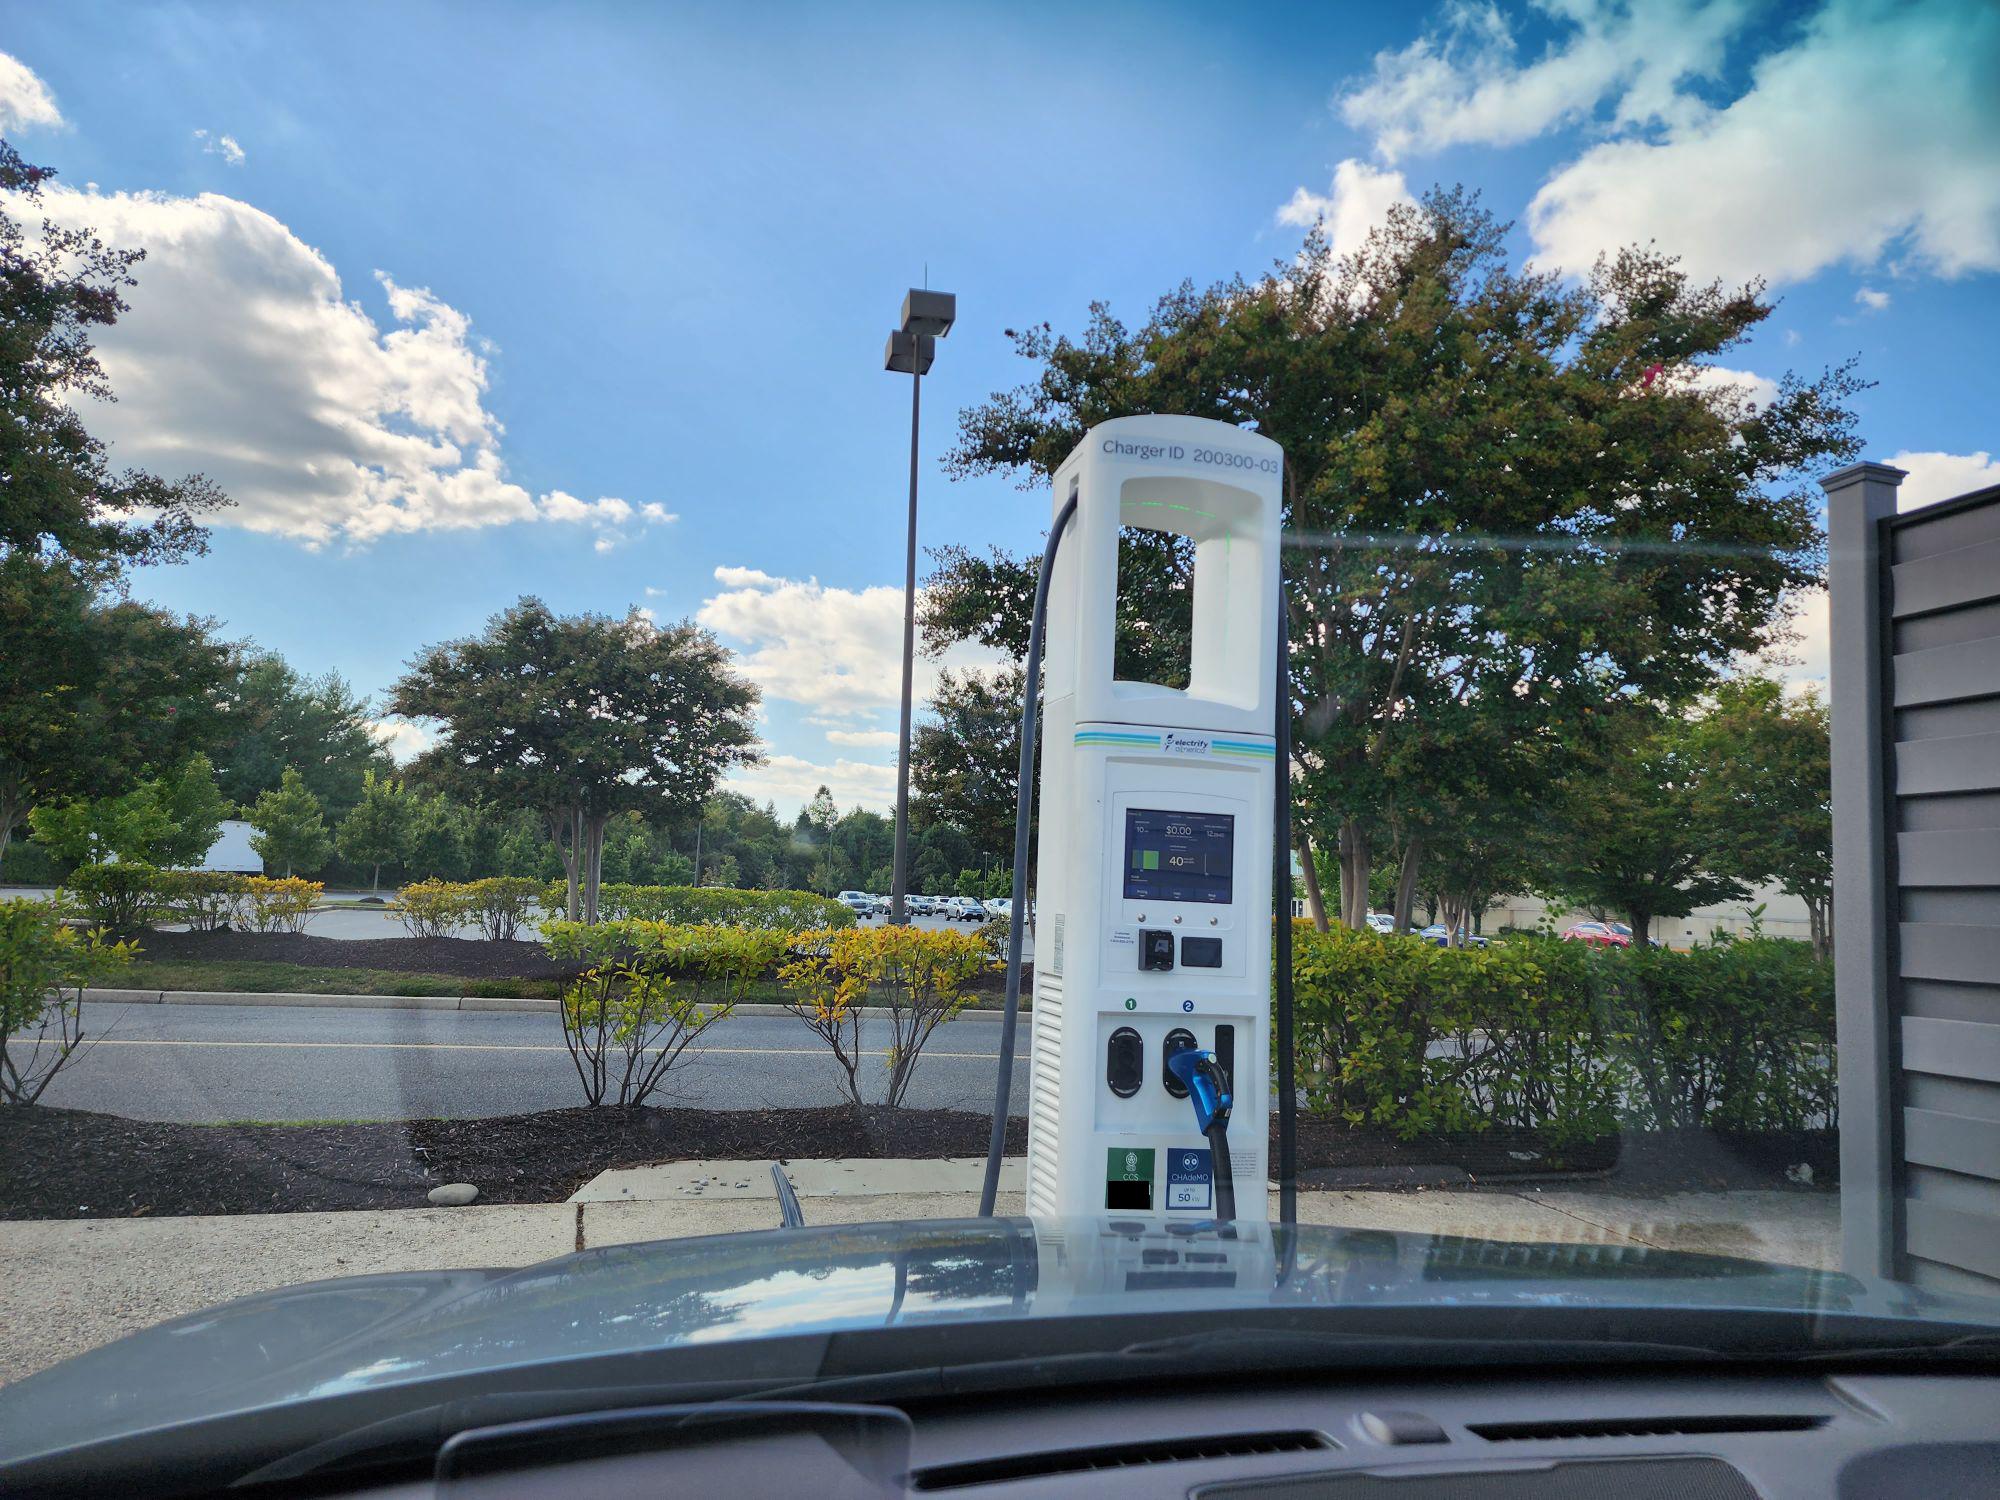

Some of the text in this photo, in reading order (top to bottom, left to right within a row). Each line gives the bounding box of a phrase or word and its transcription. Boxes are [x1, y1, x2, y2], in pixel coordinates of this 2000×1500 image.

[1102, 439, 1279, 474] Charger ID 200300-03
[1174, 739, 1209, 749] electrify
[1165, 825, 1192, 836] $0.00
[1168, 856, 1184, 867] 40
[1185, 1001, 1192, 1011] 2
[1122, 1173, 1139, 1181] CCS
[1171, 1174, 1209, 1182] CHAdeMO
[1178, 1193, 1191, 1202] 50
